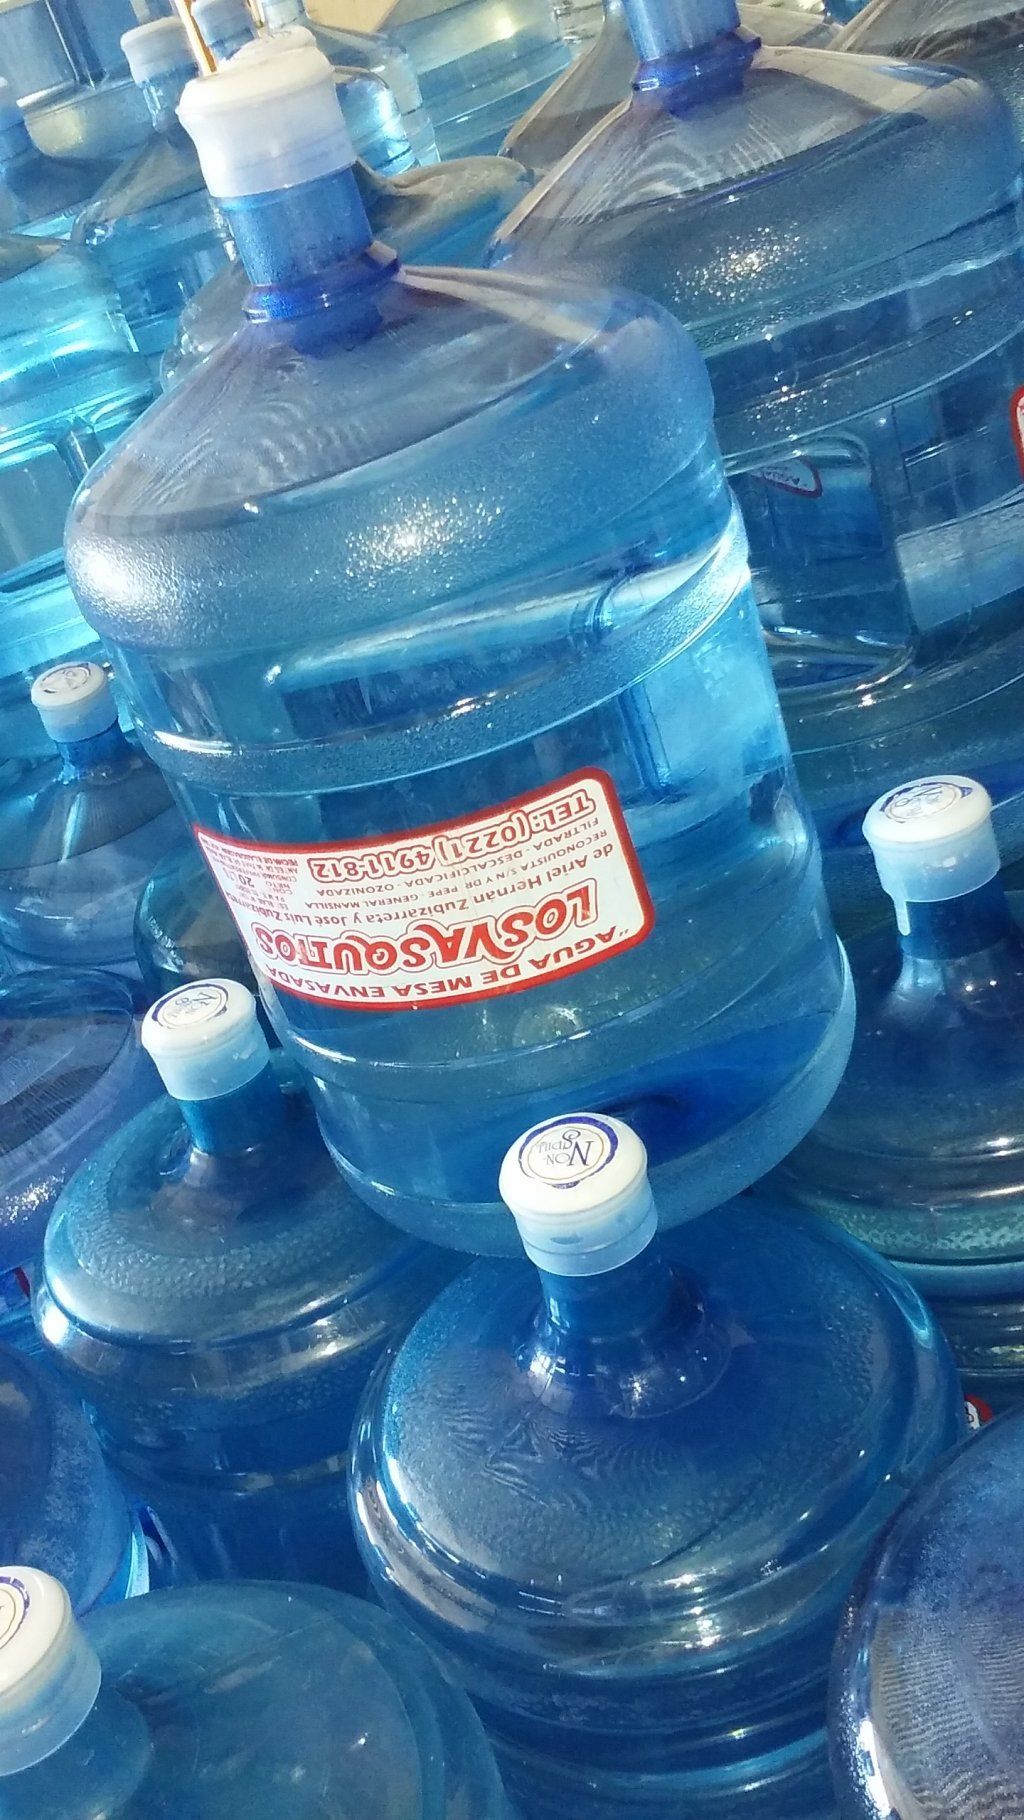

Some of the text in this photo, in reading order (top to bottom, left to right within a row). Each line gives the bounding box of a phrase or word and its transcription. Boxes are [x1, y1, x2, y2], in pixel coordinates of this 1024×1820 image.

[313, 796, 589, 878] TEL: (0221) 4911-812
[533, 817, 599, 851] FILTRADA
[520, 829, 607, 872] RECONQUISTA
[593, 843, 613, 859] de
[404, 849, 523, 888] DESCALCIFICADA
[496, 867, 517, 880] S/N
[546, 855, 588, 882] Ariel
[238, 874, 255, 888] 20
[465, 878, 481, 889] DR
[316, 884, 394, 897] OZONIZADA
[428, 885, 458, 898] PEPE
[474, 875, 542, 905] Hernán
[304, 901, 360, 909] MANSILLA
[363, 894, 418, 908] GENERAL
[283, 913, 312, 926] Luis
[353, 913, 361, 925] y
[366, 898, 468, 925] Zubizarreta
[315, 915, 347, 927] José
[266, 964, 385, 998] ENVASADA
[481, 964, 521, 984] DE
[391, 976, 472, 997] MESA
